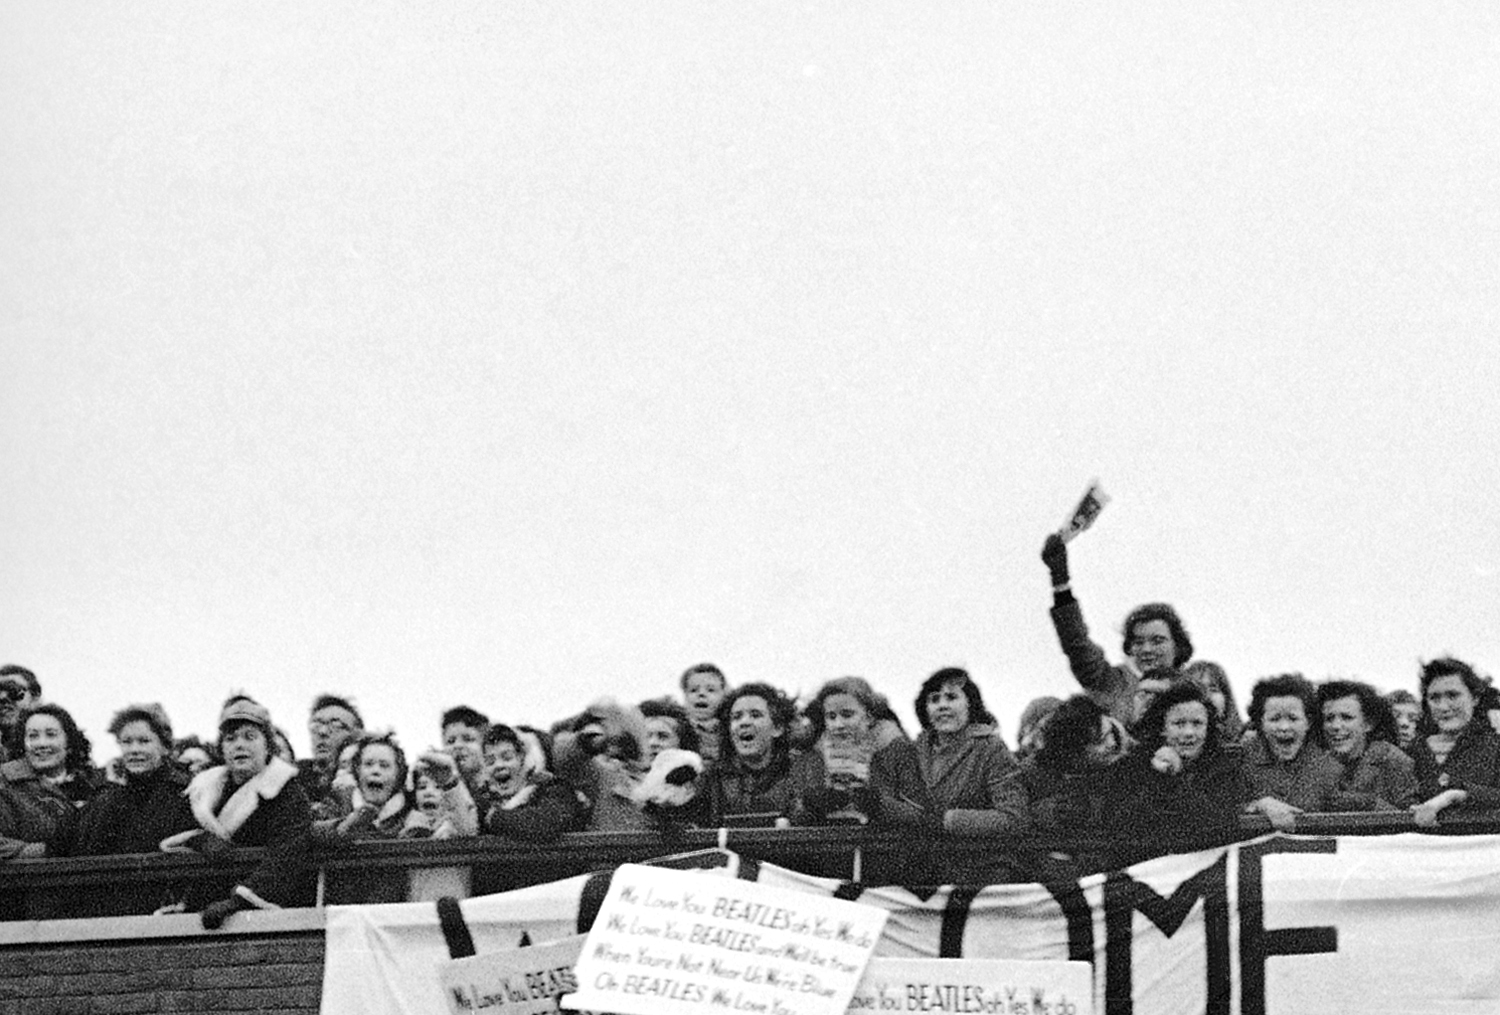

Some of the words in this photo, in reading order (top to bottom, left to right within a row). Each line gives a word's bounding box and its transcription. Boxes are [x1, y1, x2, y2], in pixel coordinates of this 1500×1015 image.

[606, 912, 627, 934] We
[629, 915, 661, 937] Love
[663, 920, 687, 942] You
[688, 923, 762, 953] BEATLES
[809, 952, 827, 967] be
[830, 956, 859, 973] true
[620, 886, 639, 905] We
[643, 887, 679, 910] Love
[682, 892, 707, 915] You
[712, 897, 797, 930] BEATLES
[813, 917, 835, 941] Yes
[836, 921, 855, 943] We
[592, 942, 632, 963] When
[677, 953, 704, 974] Not
[707, 958, 741, 980] Near
[742, 965, 763, 985] Us
[799, 974, 837, 998] Blue
[593, 972, 620, 992] Oh
[622, 974, 709, 1003] BEATLES
[710, 988, 732, 1008] We
[733, 991, 768, 1014] Love
[876, 982, 902, 1011] You
[905, 983, 985, 1013] BEATLES
[985, 991, 1004, 1015] oh
[1005, 985, 1029, 1015] Yes
